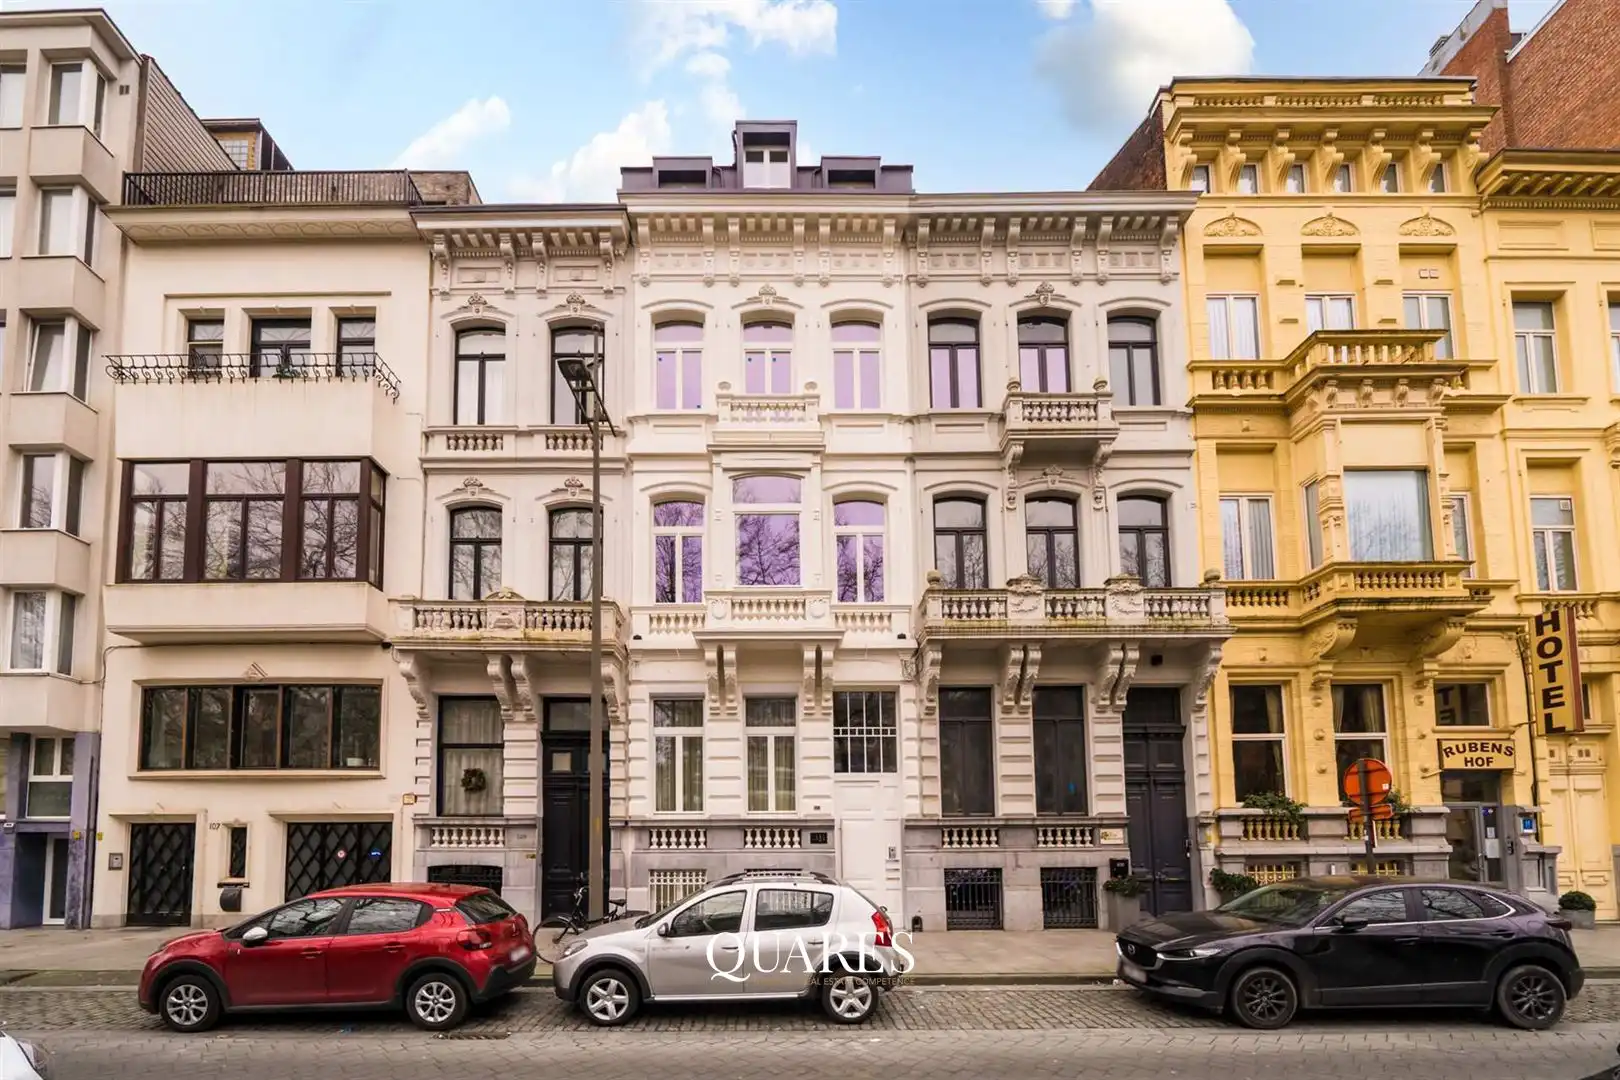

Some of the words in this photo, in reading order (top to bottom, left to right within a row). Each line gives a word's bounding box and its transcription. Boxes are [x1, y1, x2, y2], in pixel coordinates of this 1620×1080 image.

[1534, 609, 1566, 734] HOTEL
[1443, 742, 1514, 758] RUBENS
[1464, 756, 1494, 767] HOF
